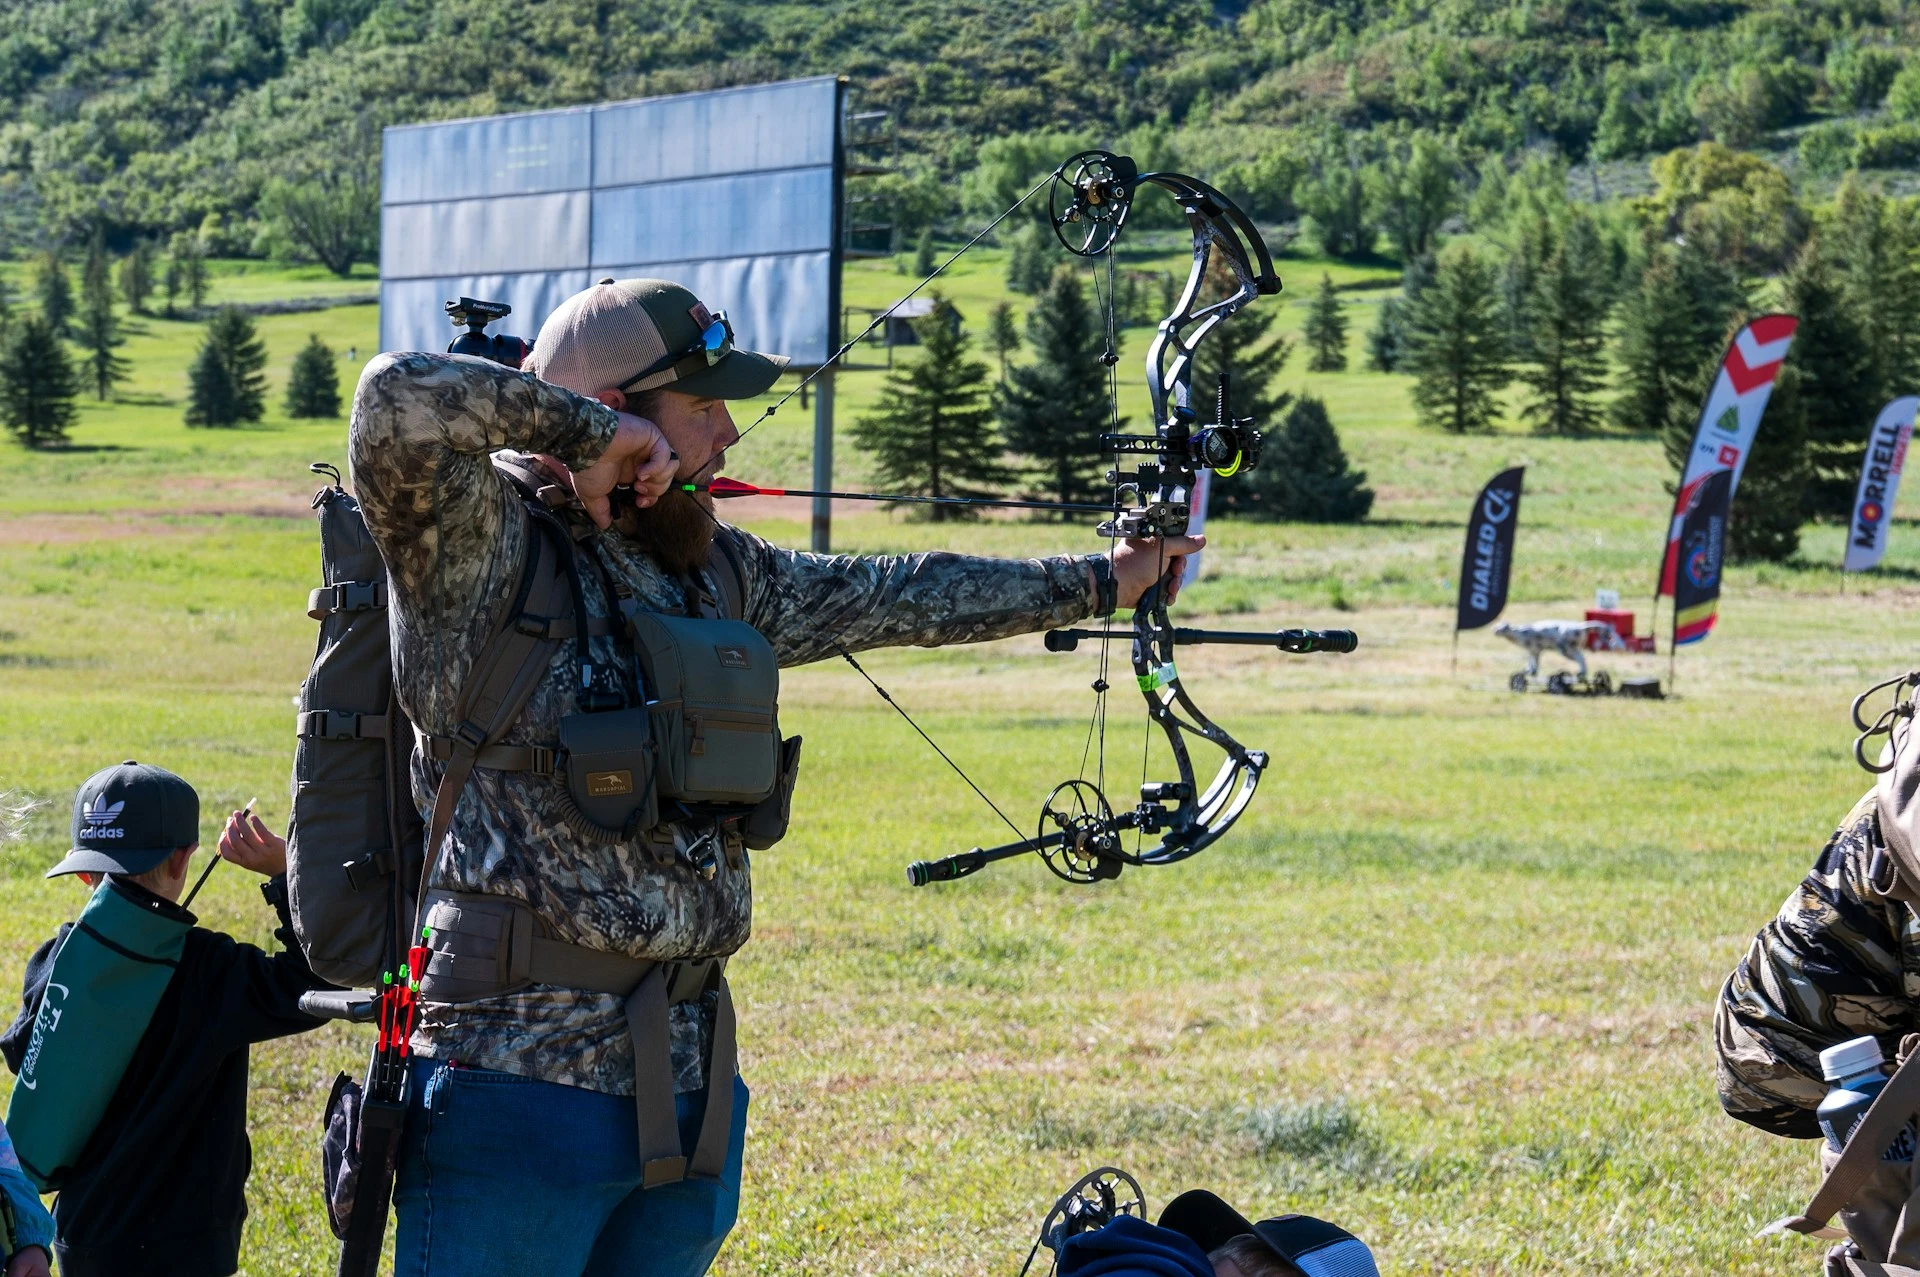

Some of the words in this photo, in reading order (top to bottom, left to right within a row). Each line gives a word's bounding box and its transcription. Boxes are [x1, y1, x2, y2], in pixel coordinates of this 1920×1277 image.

[1854, 421, 1901, 550] MORRELL
[1470, 523, 1498, 612] DIALED
[79, 826, 125, 839] adidas
[28, 1036, 44, 1075] OUTDOOR
